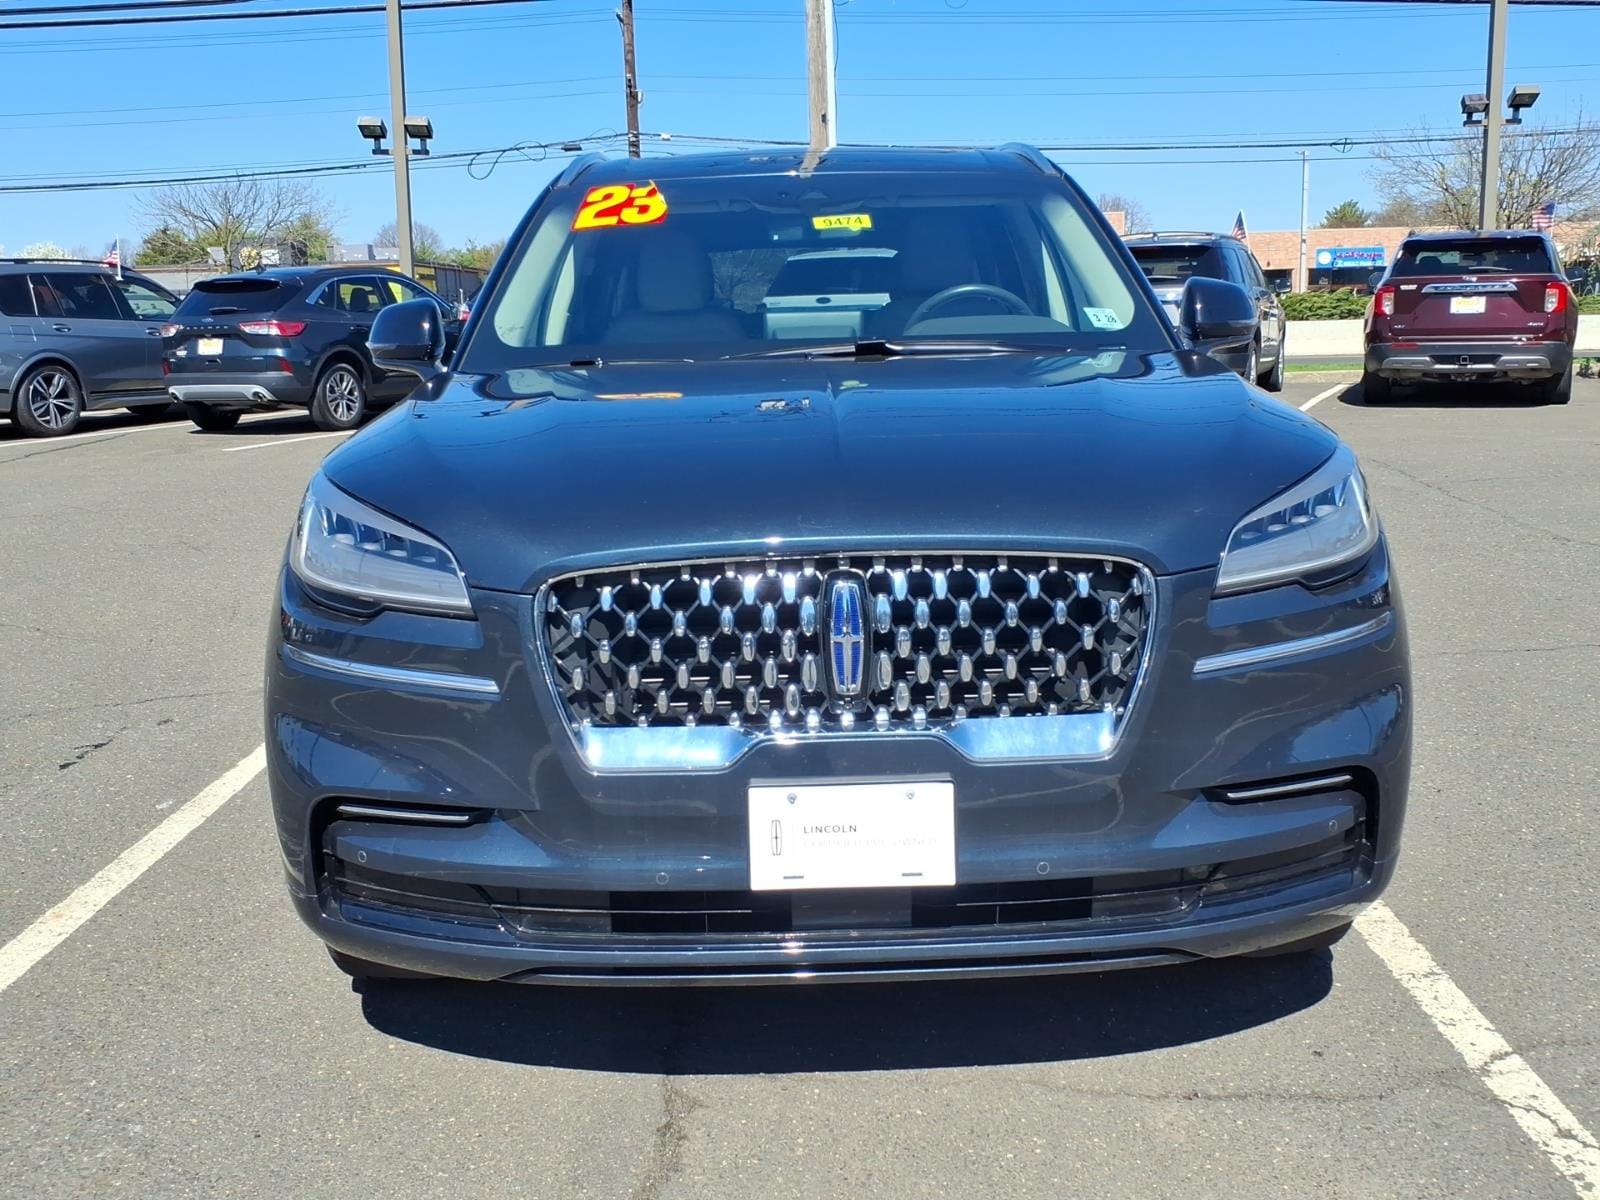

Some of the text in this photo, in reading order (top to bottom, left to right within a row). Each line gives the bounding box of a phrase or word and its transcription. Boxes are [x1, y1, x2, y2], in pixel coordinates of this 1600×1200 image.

[573, 181, 668, 229] 23
[822, 215, 864, 227] 9474
[803, 825, 858, 834] LINCOLN
